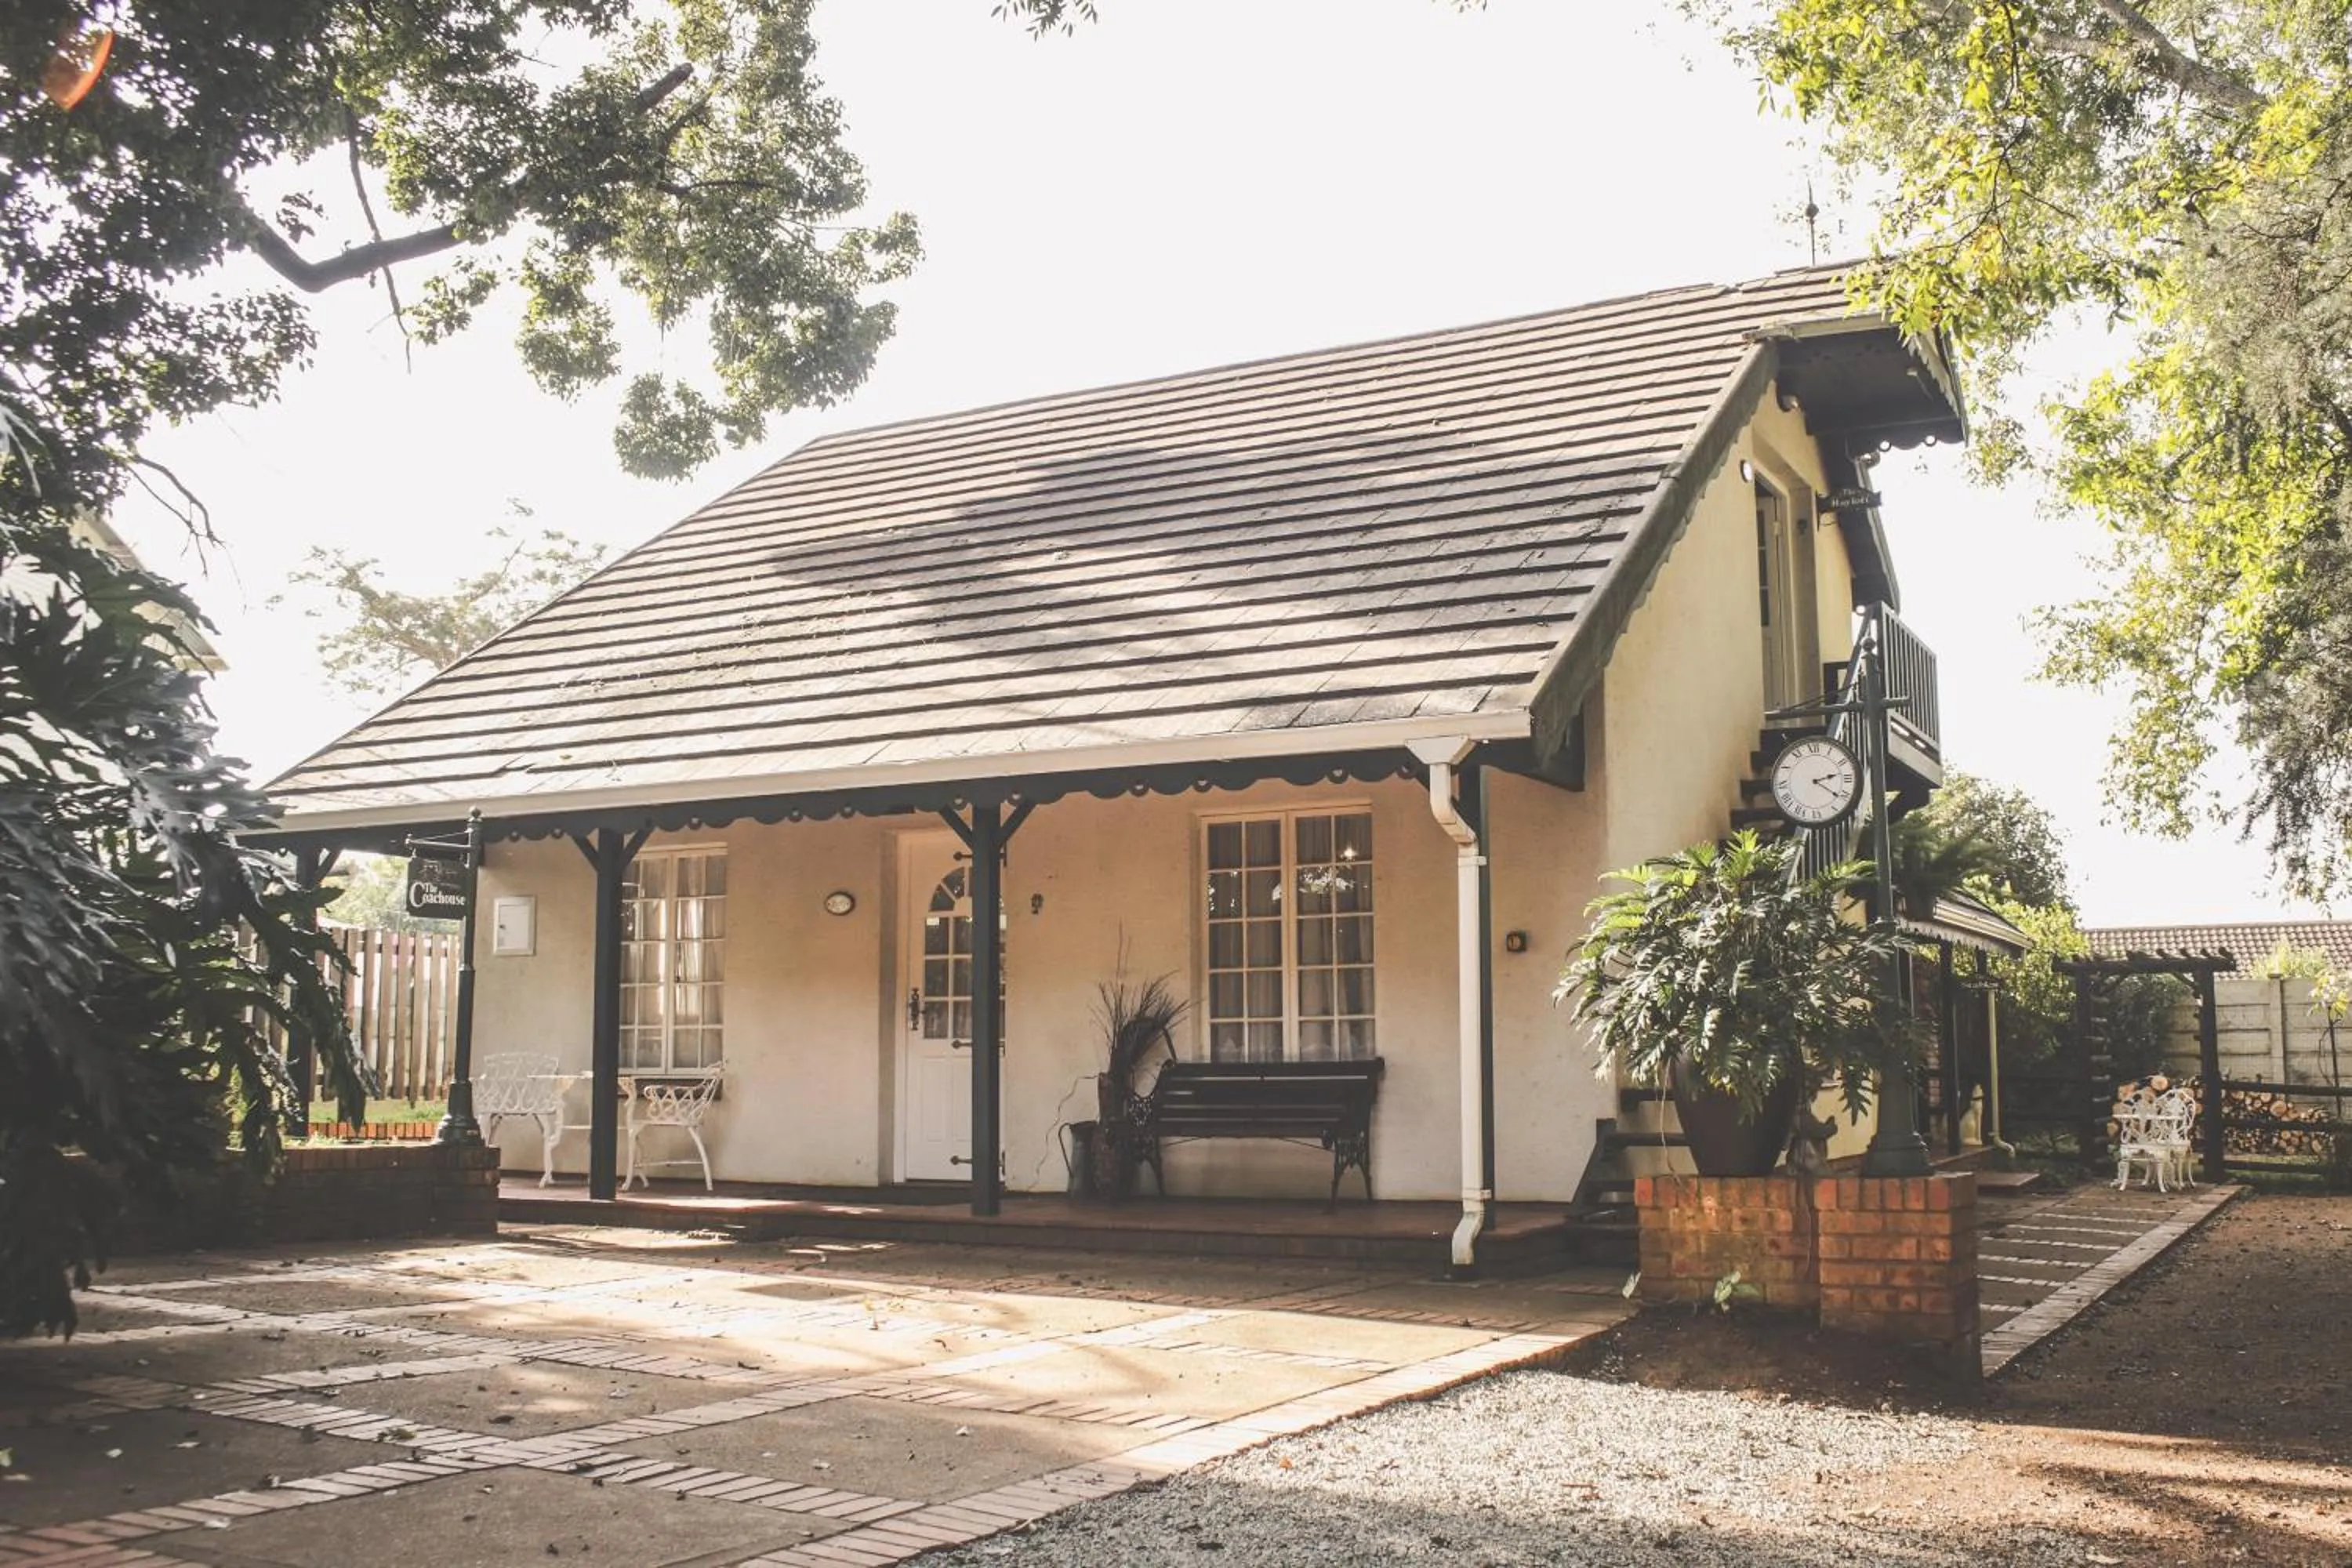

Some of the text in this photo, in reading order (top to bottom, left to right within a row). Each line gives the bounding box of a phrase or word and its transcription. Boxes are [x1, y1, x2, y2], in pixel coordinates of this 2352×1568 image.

[1806, 742, 1820, 753] XII
[1837, 758, 1846, 767] II
[1843, 774, 1853, 782] III
[423, 882, 438, 893] The
[409, 881, 466, 908] Coachouse
